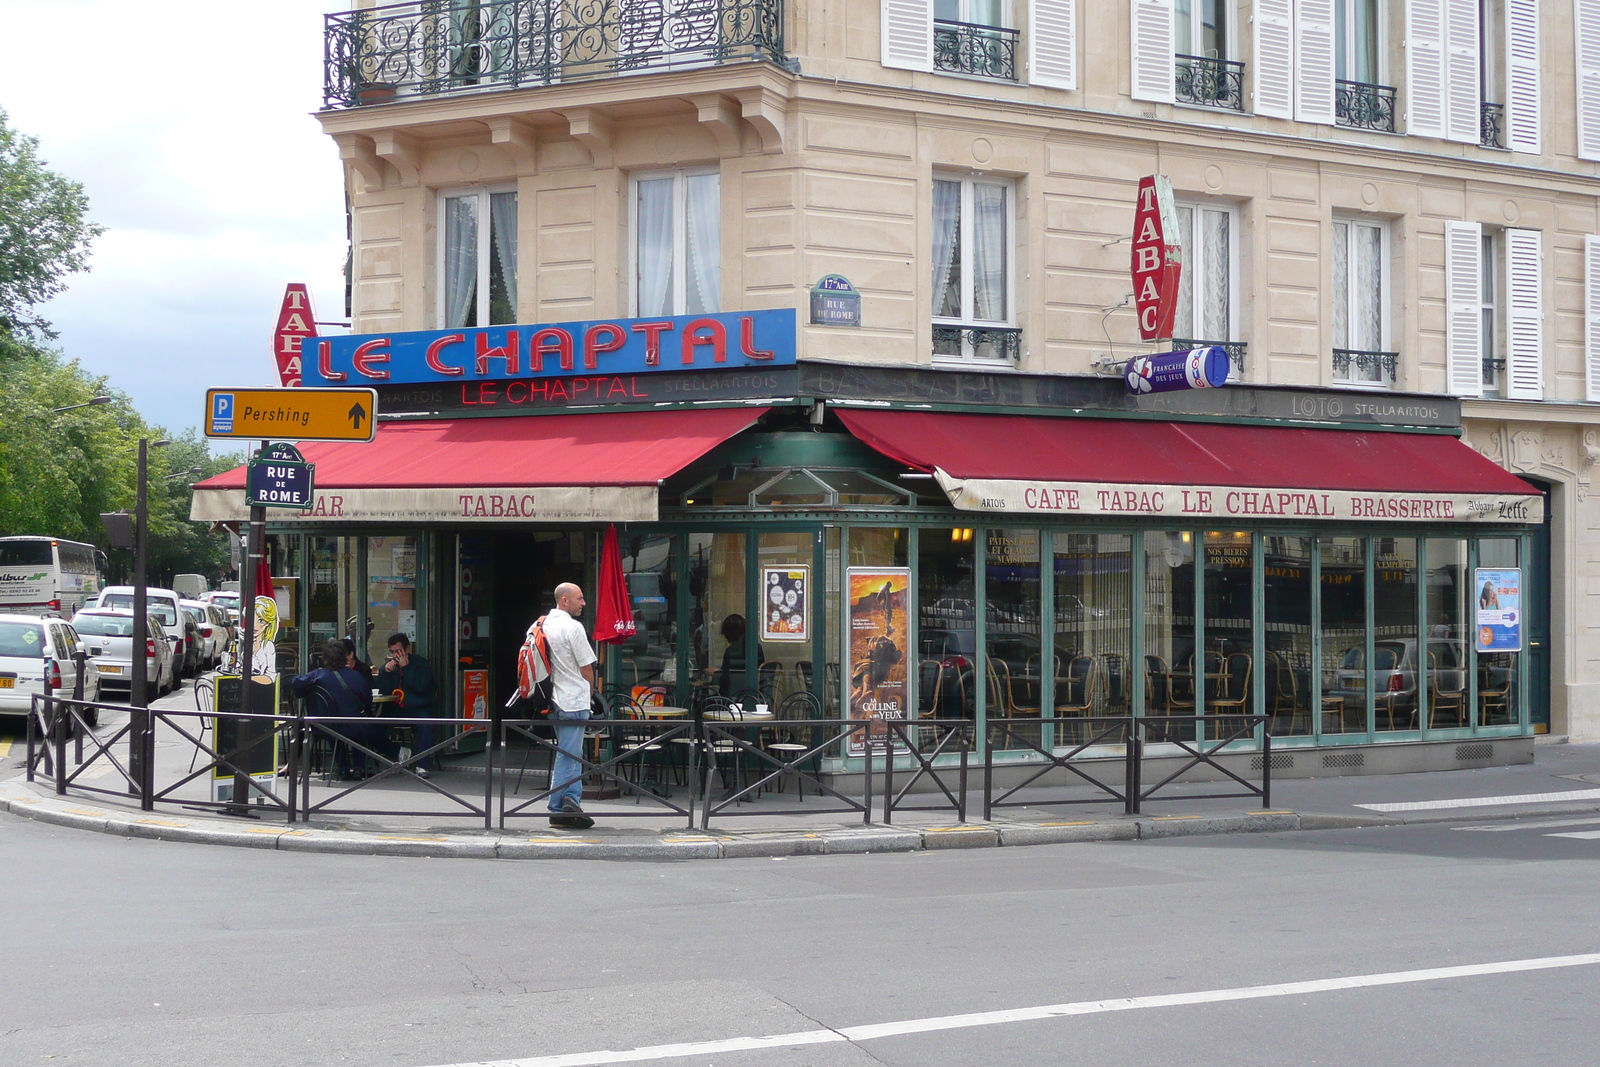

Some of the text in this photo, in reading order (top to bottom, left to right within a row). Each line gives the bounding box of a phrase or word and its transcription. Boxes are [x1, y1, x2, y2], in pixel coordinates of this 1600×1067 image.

[1136, 186, 1161, 332] TABAC
[827, 300, 845, 309] RUE
[817, 309, 854, 320] DE ROME
[281, 290, 311, 387] TABA
[318, 316, 775, 381] LE CHAPTAL
[1168, 373, 1184, 382] JEUX
[461, 376, 649, 405] LE CHAPTAL
[1292, 395, 1344, 418] LOTO
[243, 406, 310, 426] Pershing
[267, 466, 296, 479] RUE
[259, 489, 301, 503] ROME
[981, 498, 1006, 508] ARTOIS
[1024, 488, 1455, 518] CAFE TABAC LE CHAPTAL BRASSERIE
[459, 494, 535, 517] TABAC
[1497, 501, 1528, 519] Leffe
[1207, 548, 1222, 556] NOS
[1211, 556, 1245, 564] PRESSION
[862, 702, 897, 711] COLLINE
[879, 710, 902, 720] YEUX
